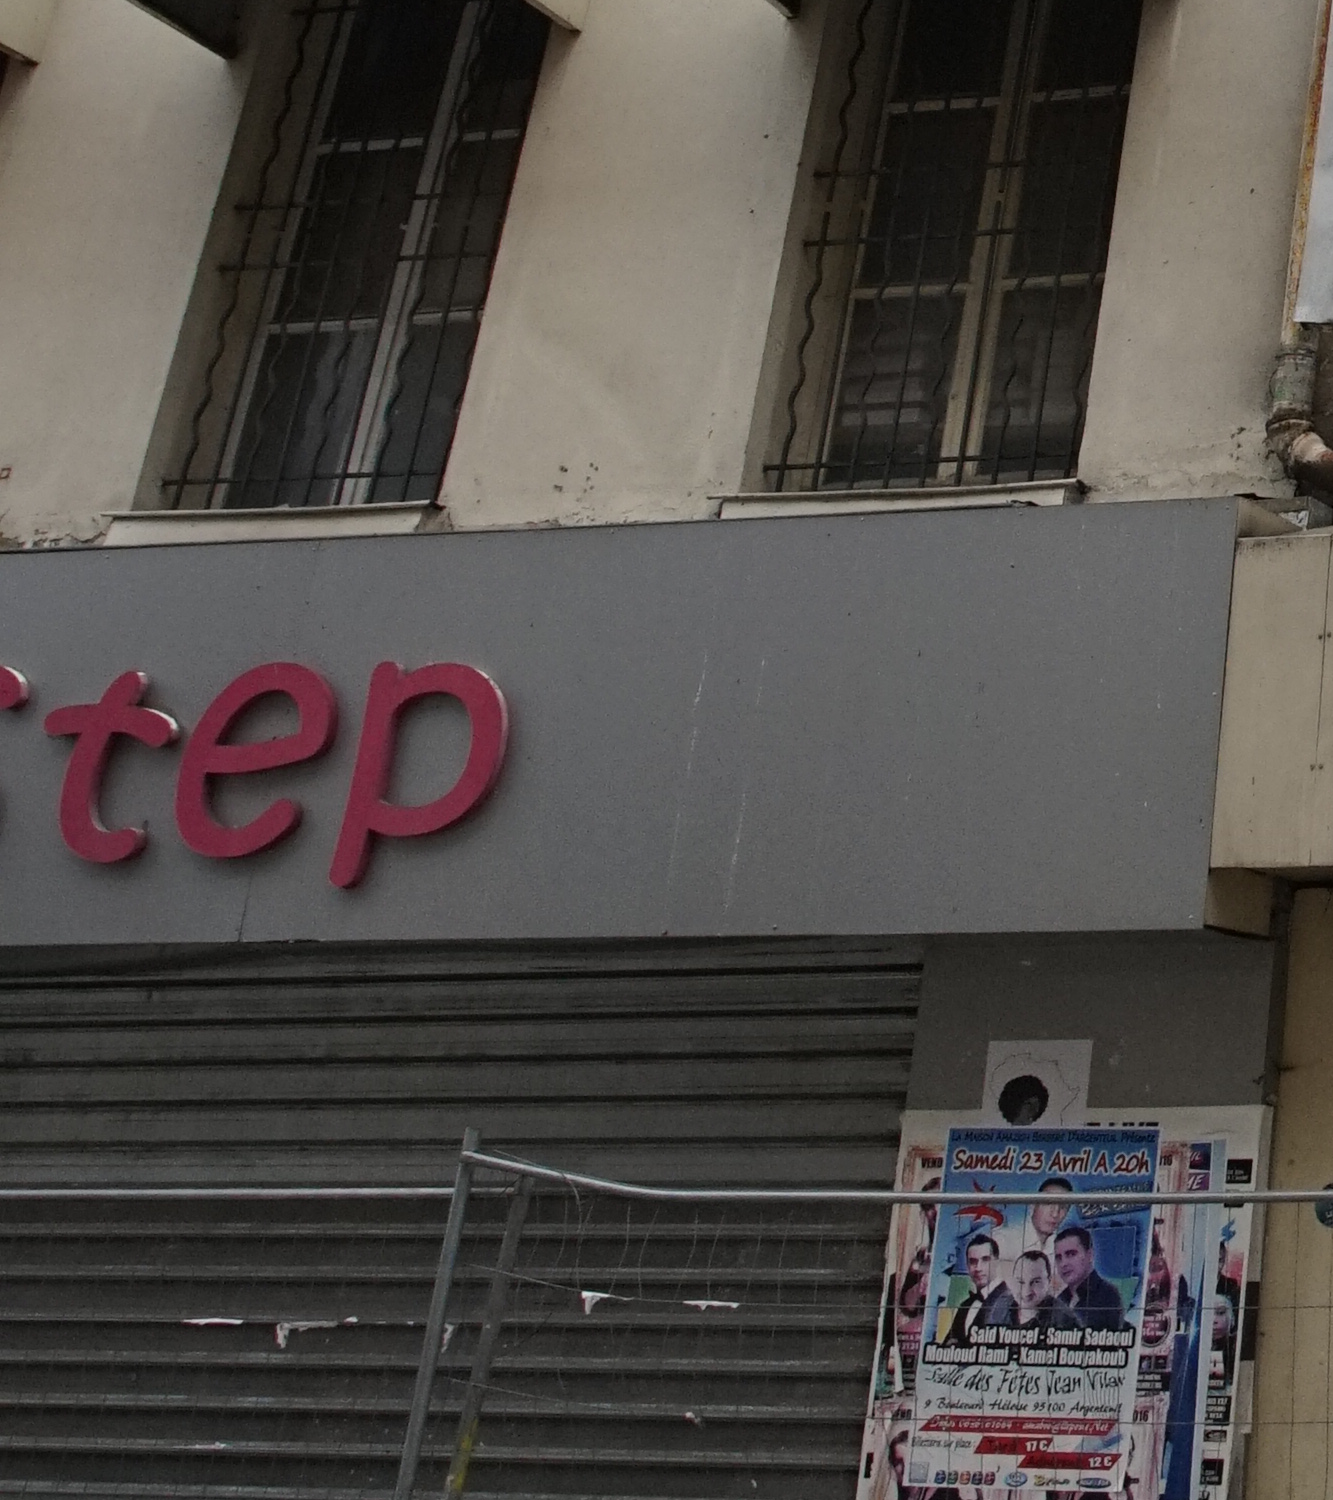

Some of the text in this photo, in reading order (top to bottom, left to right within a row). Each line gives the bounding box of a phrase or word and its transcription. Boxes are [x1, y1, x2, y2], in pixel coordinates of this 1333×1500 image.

[0, 660, 508, 891] tep
[952, 1146, 1150, 1174] Samedi 23 Avril A 20h
[998, 1327, 1038, 1345] Youcef
[1047, 1328, 1082, 1346] Samir
[1084, 1328, 1133, 1348] Sadaoui
[925, 1345, 977, 1363] Mouloud
[978, 1346, 1009, 1364] Rami
[1020, 1348, 1057, 1365] Kamel
[1059, 1349, 1126, 1367] Bouyakoub
[925, 1367, 962, 1387] Salle
[965, 1367, 993, 1394] des
[1046, 1369, 1081, 1395] Jean
[936, 1398, 984, 1410] Boulevard
[1033, 1402, 1066, 1412] 95100
[1067, 1402, 1122, 1416] Argenteuil
[1089, 1456, 1102, 1467] 12
